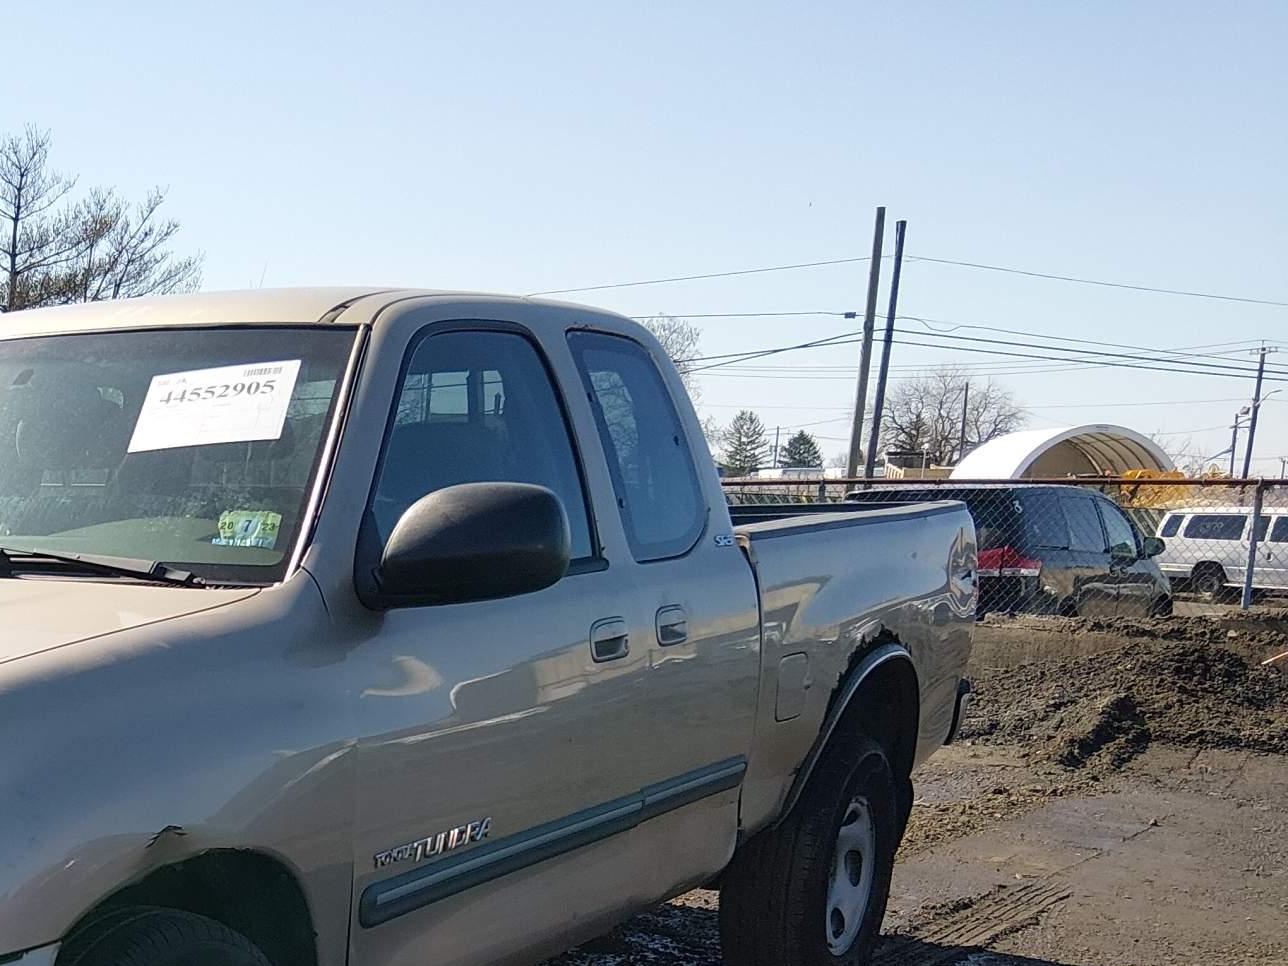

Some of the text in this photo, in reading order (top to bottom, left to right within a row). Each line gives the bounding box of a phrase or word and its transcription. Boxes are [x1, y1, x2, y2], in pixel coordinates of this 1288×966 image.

[159, 379, 277, 405] 44552905
[219, 521, 234, 531] 20
[243, 519, 253, 533] 7
